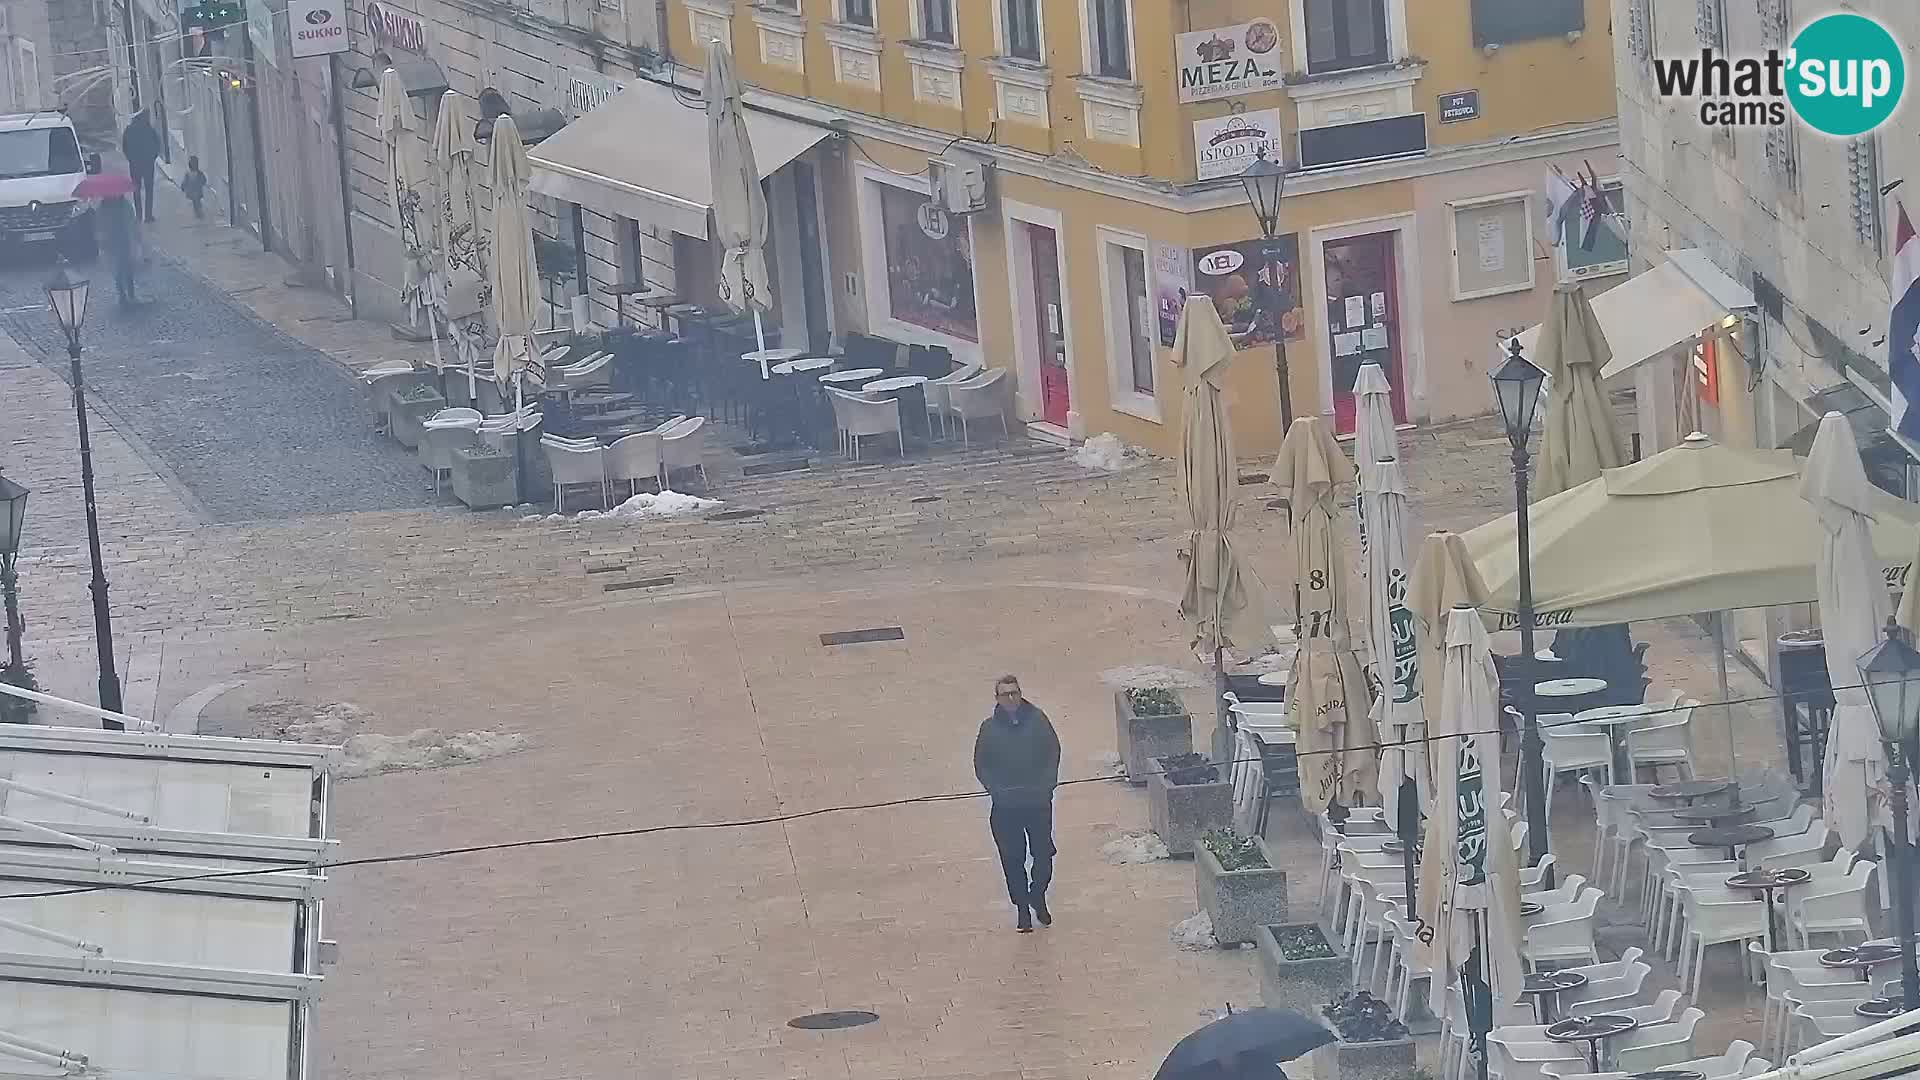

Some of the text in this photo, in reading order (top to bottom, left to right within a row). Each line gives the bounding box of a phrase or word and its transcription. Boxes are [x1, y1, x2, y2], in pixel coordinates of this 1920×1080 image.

[298, 26, 342, 41] SUKNO
[383, 10, 424, 49] SUKNO
[1181, 58, 1261, 89] MEZA
[1452, 97, 1464, 106] PUT
[1200, 143, 1246, 161] ISPOD
